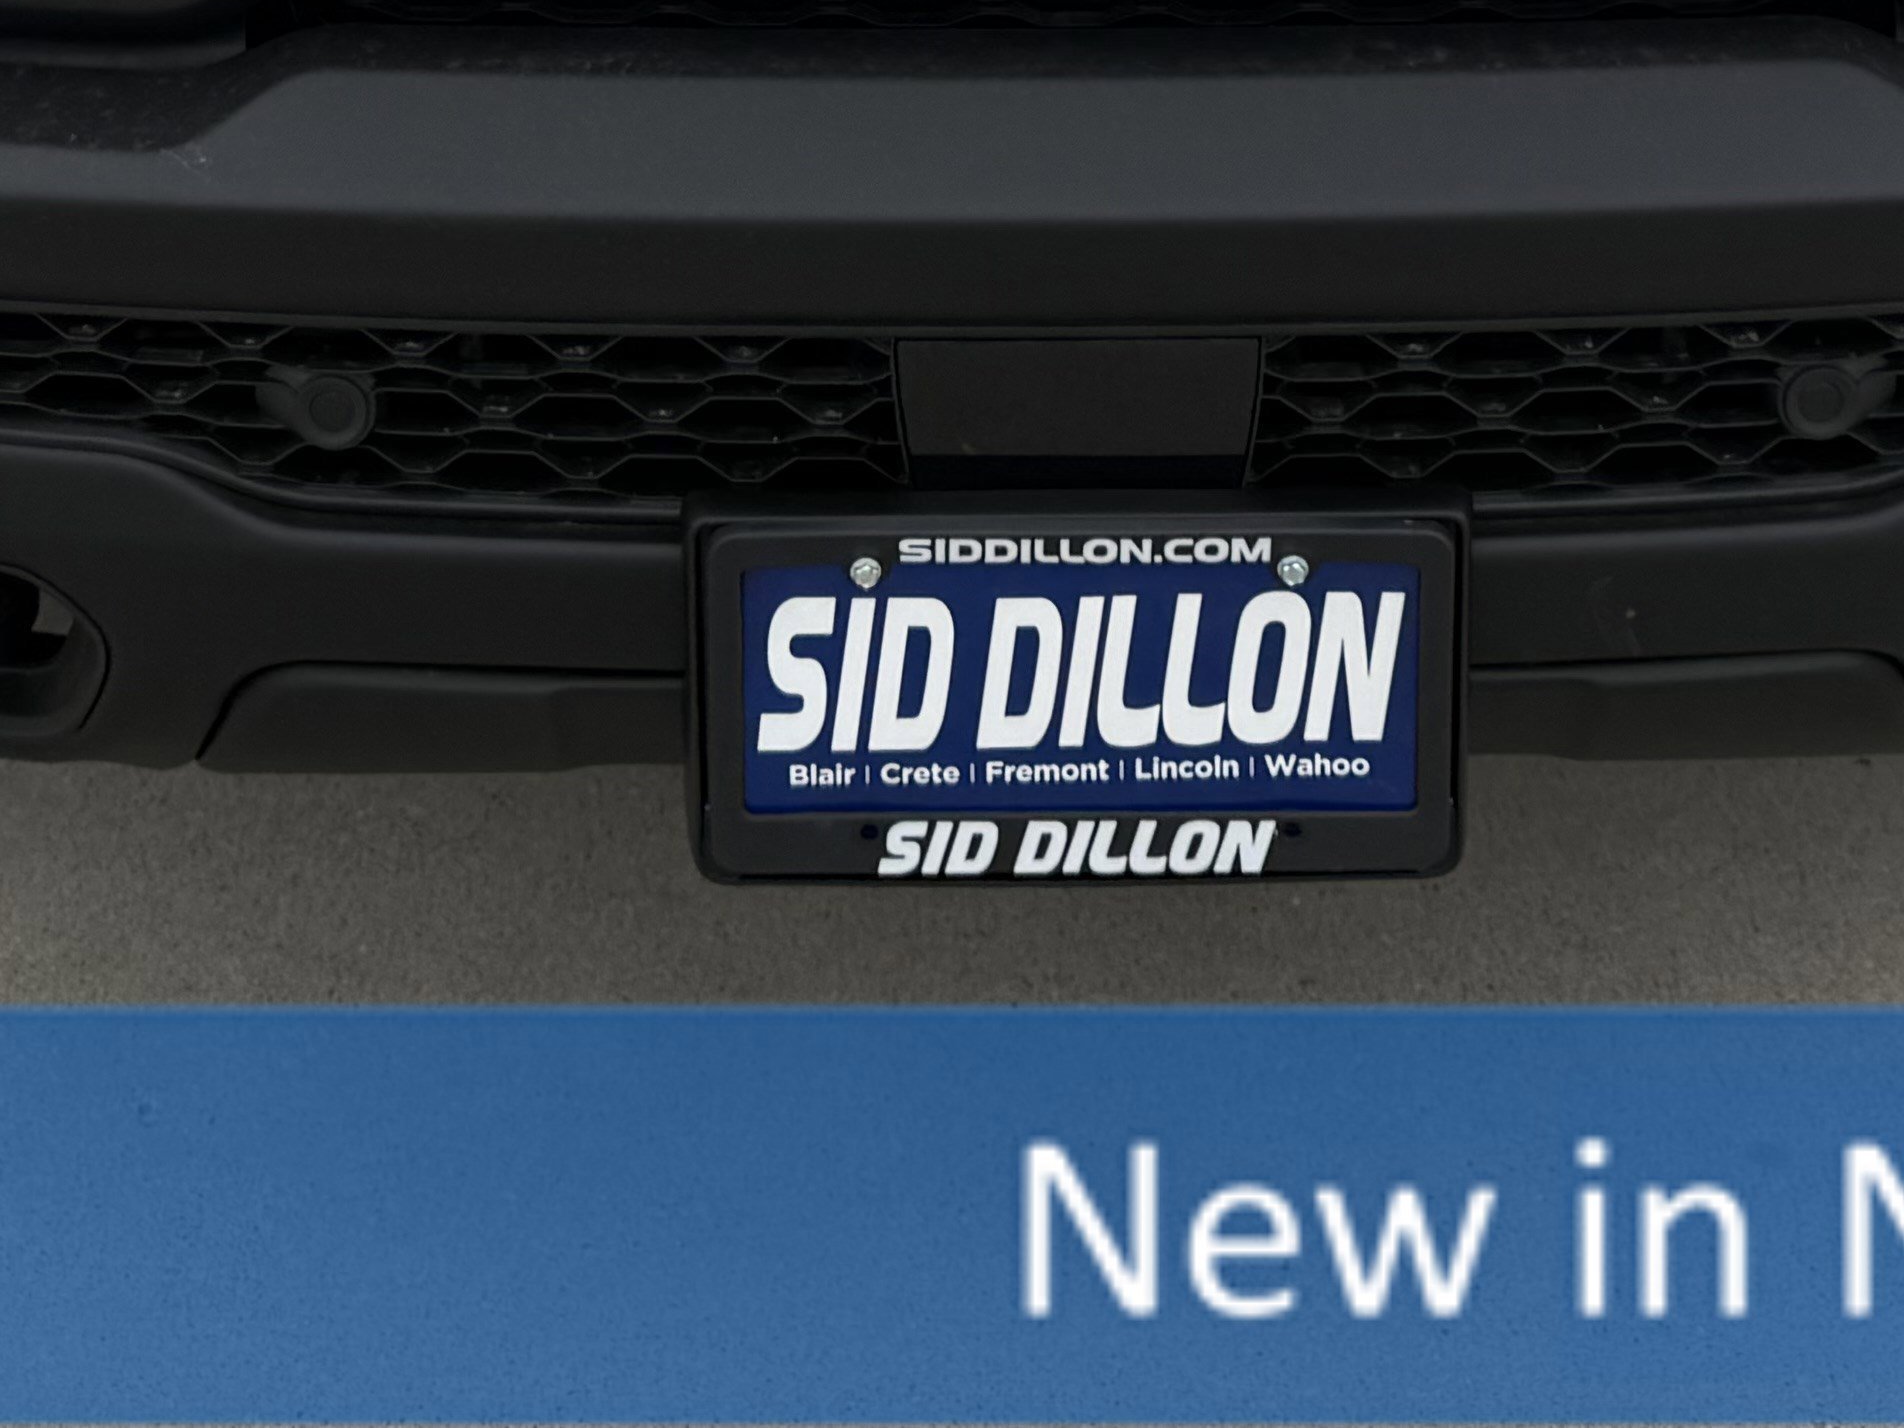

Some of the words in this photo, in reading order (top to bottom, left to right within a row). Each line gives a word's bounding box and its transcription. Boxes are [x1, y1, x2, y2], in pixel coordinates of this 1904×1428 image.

[898, 537, 1273, 565] SIDDILLON.COM
[757, 596, 956, 752] SID
[976, 590, 1407, 750] DILLON
[789, 761, 857, 786] Blair
[880, 761, 961, 785] Crete
[985, 759, 1110, 784] Fremont
[1134, 755, 1241, 781] Lincoln
[1264, 754, 1371, 778] Wahoo
[877, 820, 999, 875] SID
[1013, 819, 1277, 874] DILLON
